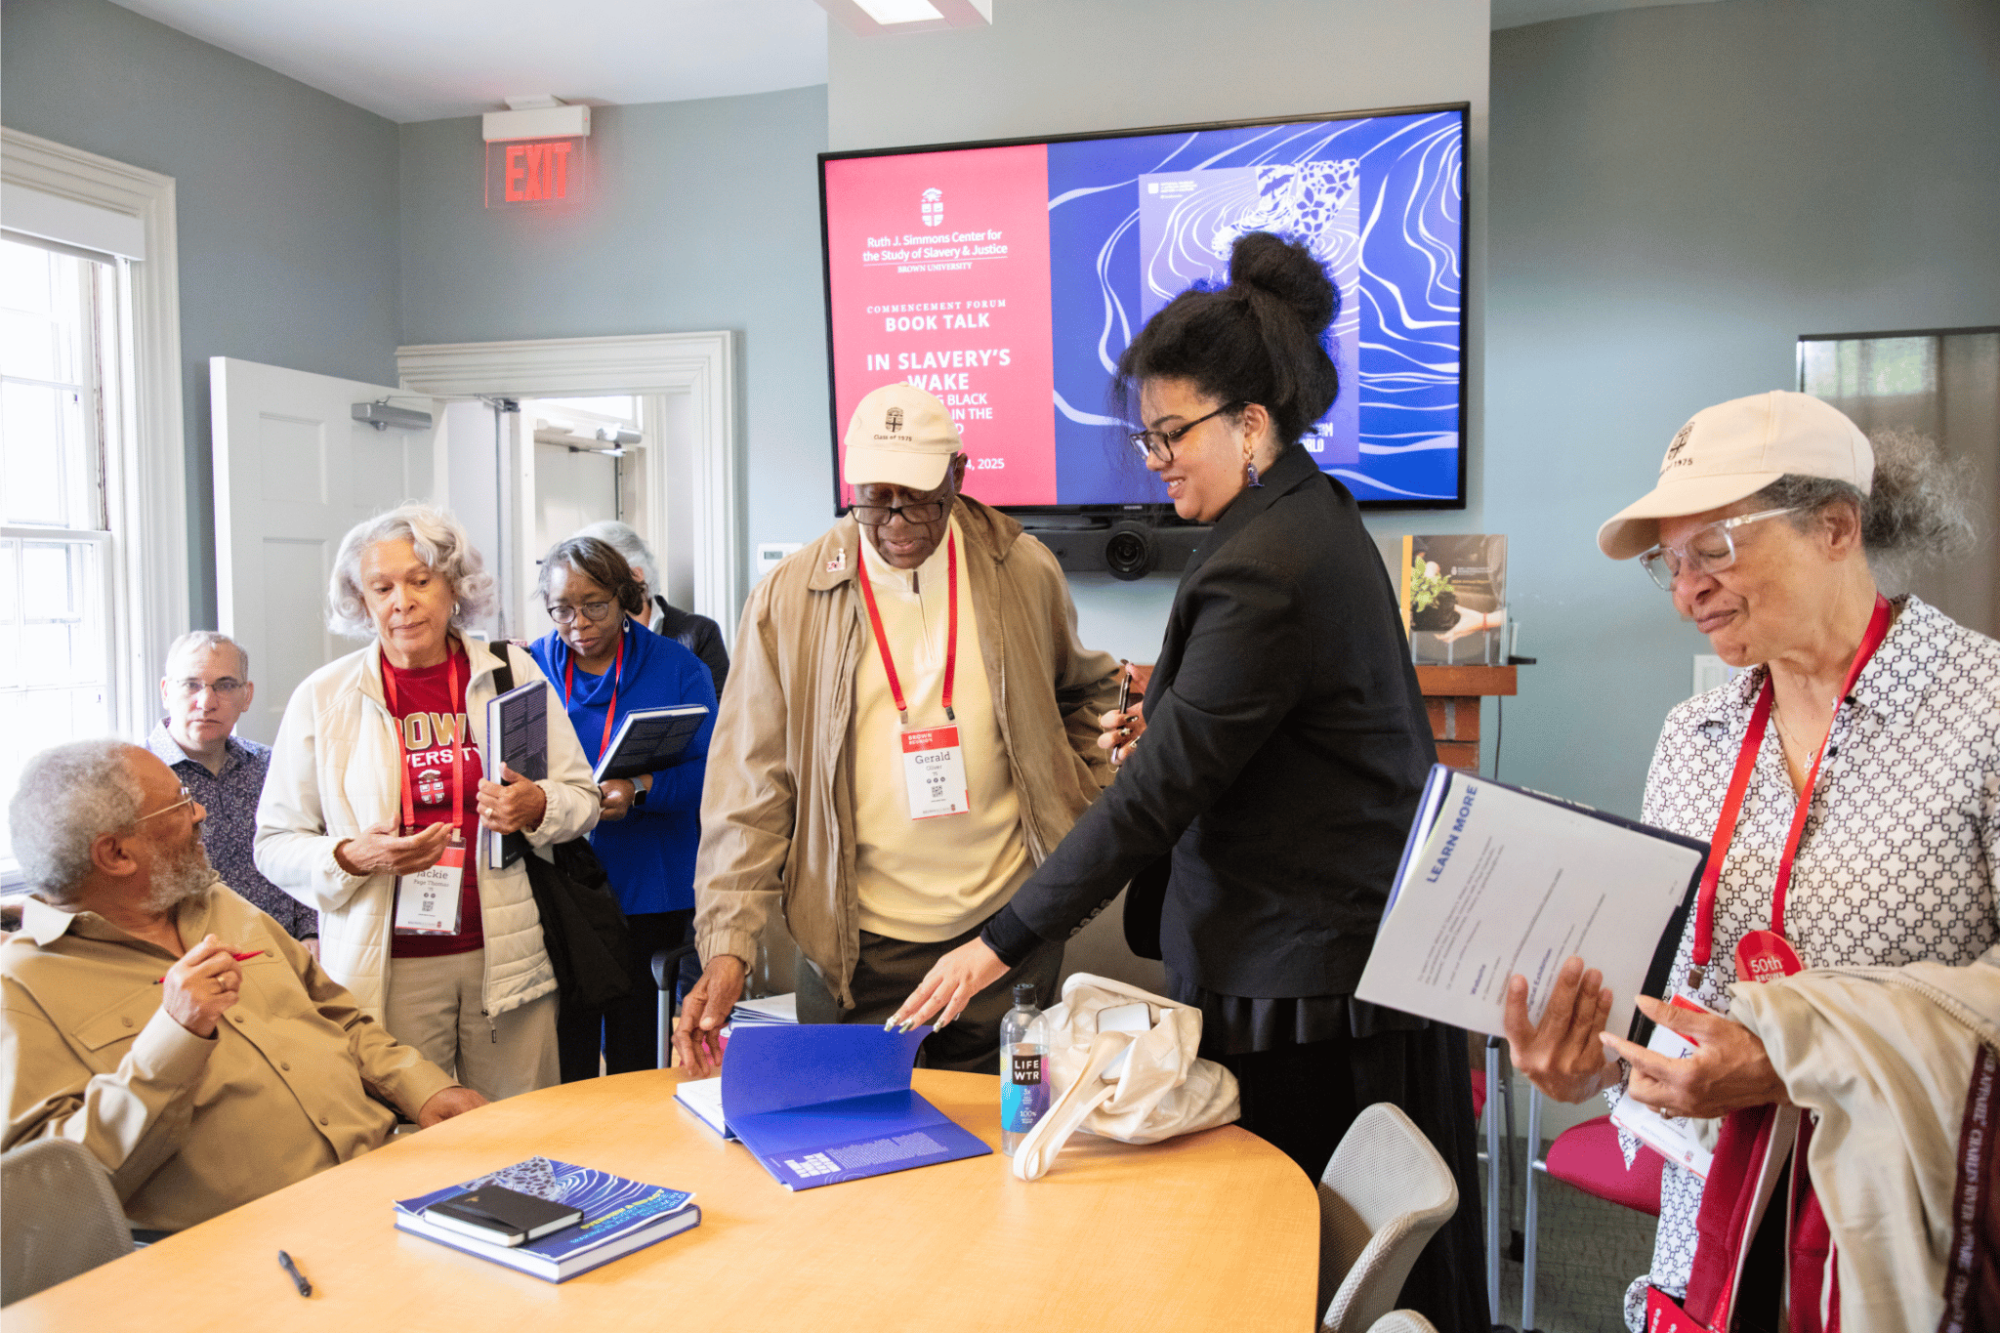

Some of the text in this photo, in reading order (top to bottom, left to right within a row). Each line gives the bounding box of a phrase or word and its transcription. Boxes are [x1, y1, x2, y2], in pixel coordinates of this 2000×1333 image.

[505, 142, 571, 202] EXIT
[867, 229, 1002, 248] Ruth J. Simmons Center for
[863, 243, 1008, 264] the Study of Slavery & Justice
[897, 261, 973, 273] BROWN UNIVERSITY
[866, 299, 1006, 314] COMMENCEMENT FORUM
[885, 312, 990, 332] BOOK TALK
[867, 354, 890, 371] IN
[907, 373, 969, 392] WAKE
[947, 393, 988, 406] BLACK
[951, 407, 993, 420] IN THE
[897, 434, 913, 443] 1975
[977, 458, 1005, 469] 2025
[915, 751, 951, 764] Gerald
[1426, 784, 1479, 884] LEARN MORE
[1751, 956, 1783, 973] 50th
[1014, 1059, 1039, 1070] LIFE
[1014, 1071, 1039, 1081] WTR
